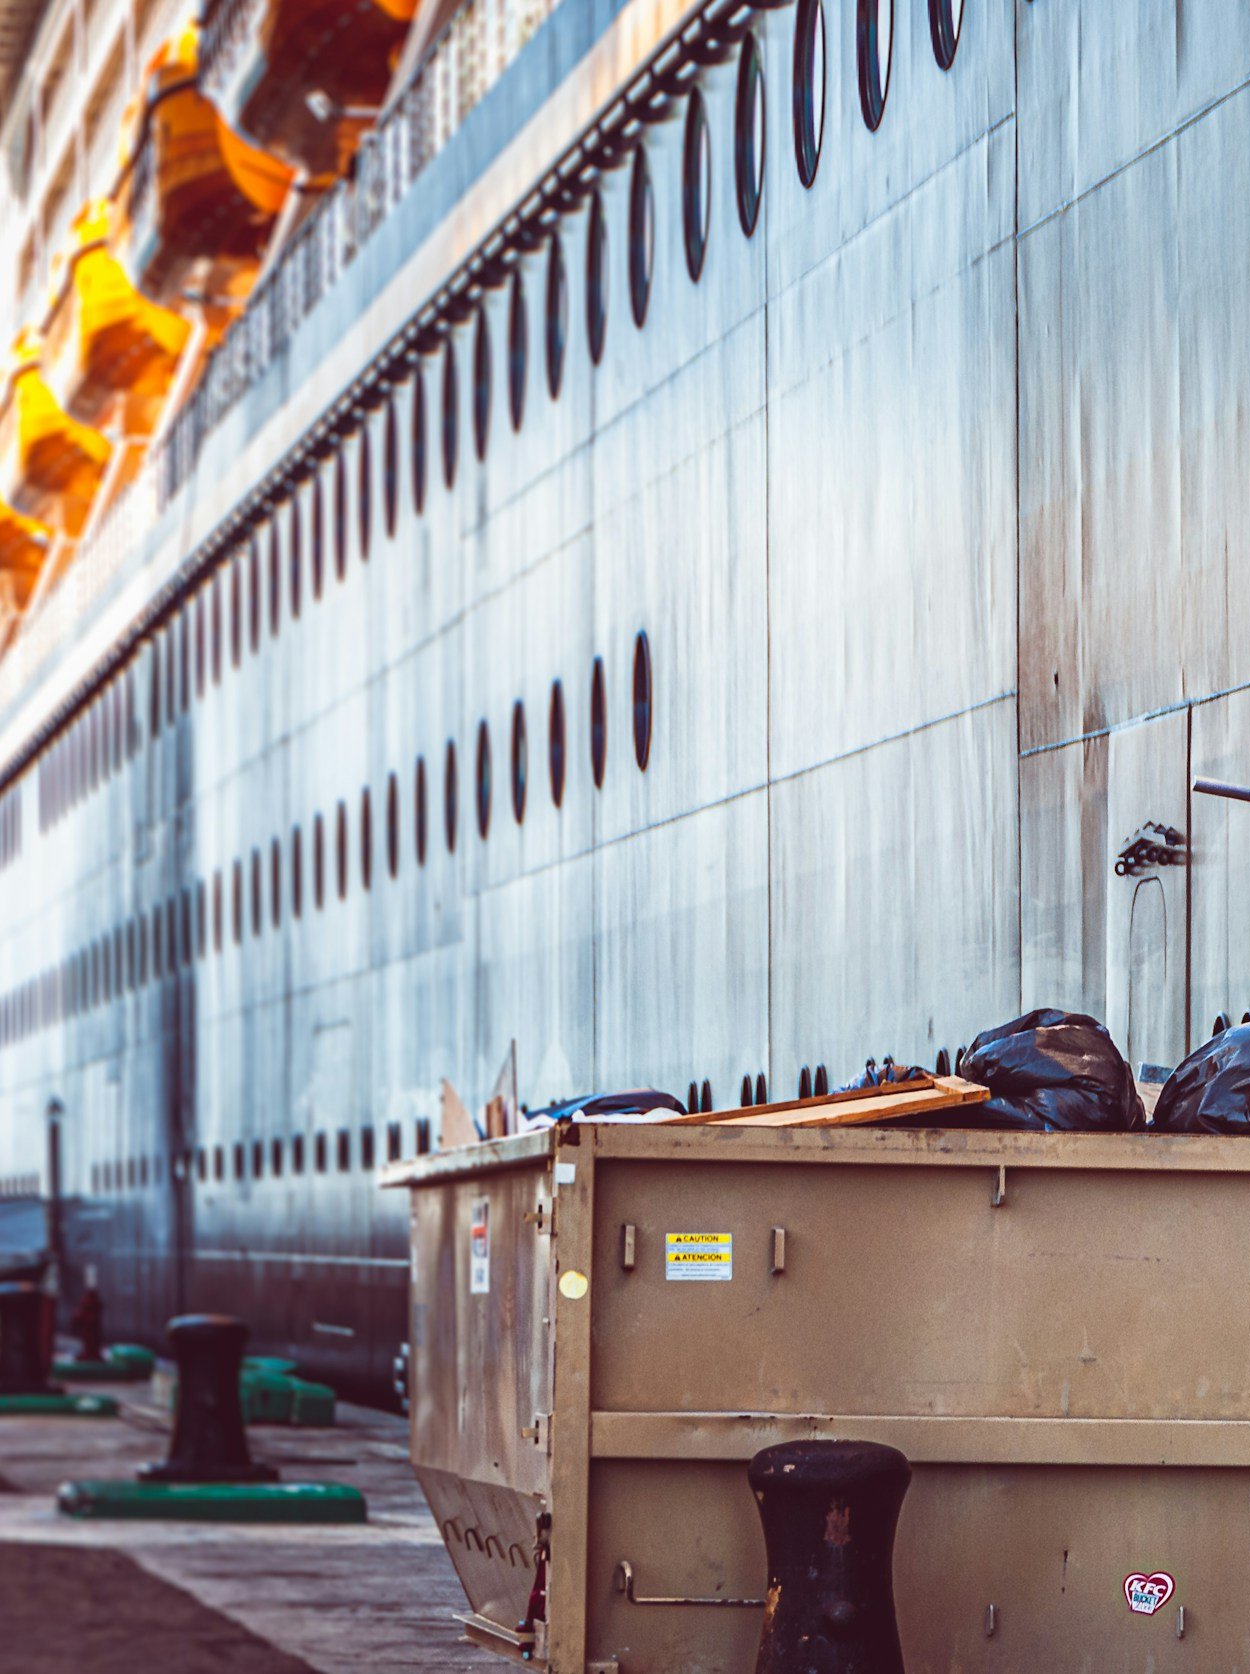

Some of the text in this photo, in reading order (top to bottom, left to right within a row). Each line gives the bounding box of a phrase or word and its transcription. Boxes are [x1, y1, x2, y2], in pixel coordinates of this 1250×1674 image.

[683, 1235, 719, 1243] CAUTION
[682, 1253, 722, 1261] ATENCION
[1129, 1580, 1166, 1597] KFC
